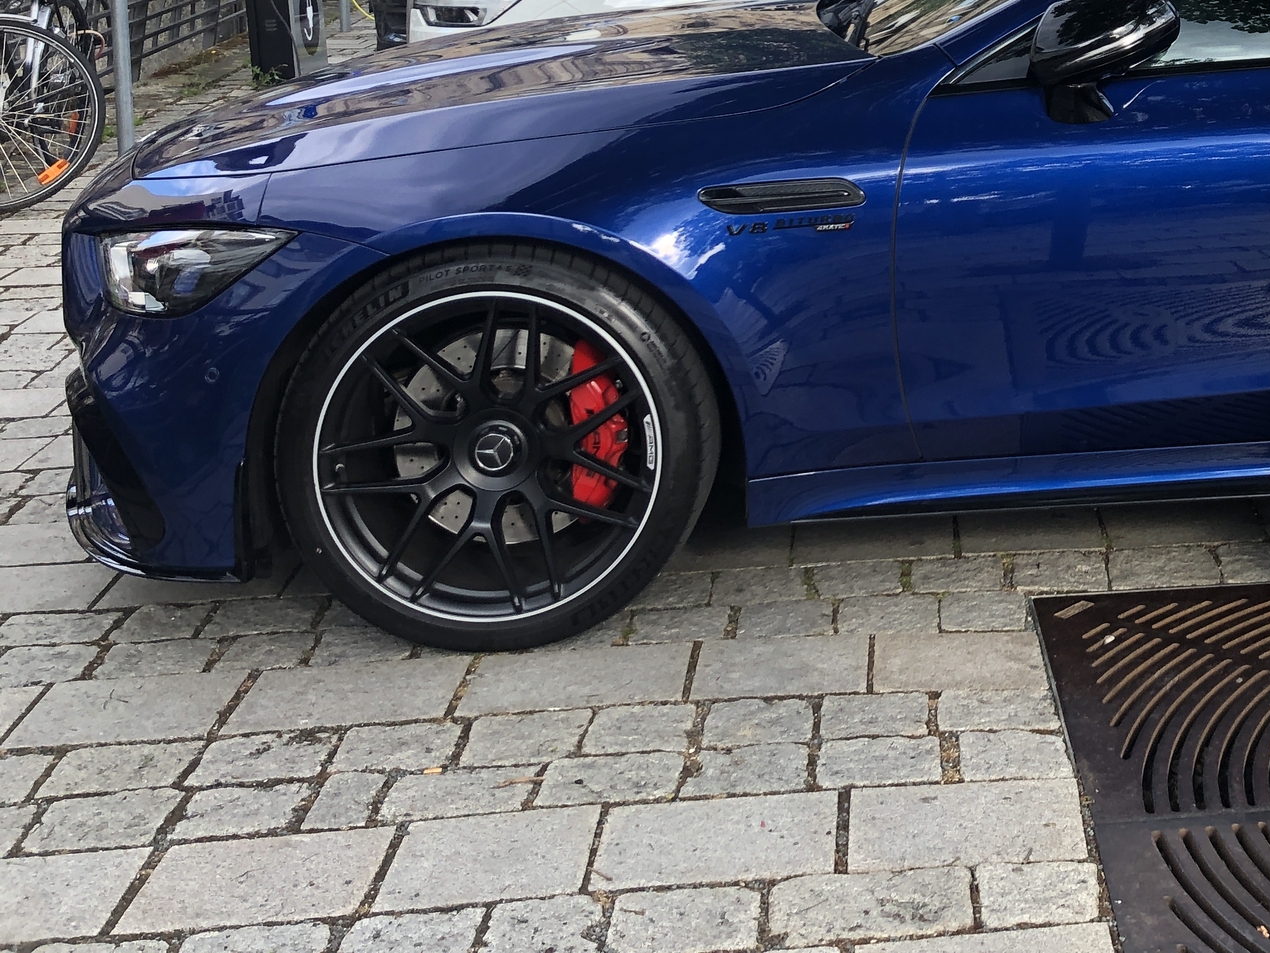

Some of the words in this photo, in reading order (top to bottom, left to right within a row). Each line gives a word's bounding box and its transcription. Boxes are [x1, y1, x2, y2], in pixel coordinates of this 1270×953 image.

[726, 221, 769, 236] V8
[774, 213, 855, 229] BITURBO
[418, 269, 451, 283] PILOT
[455, 264, 496, 275] SPORT
